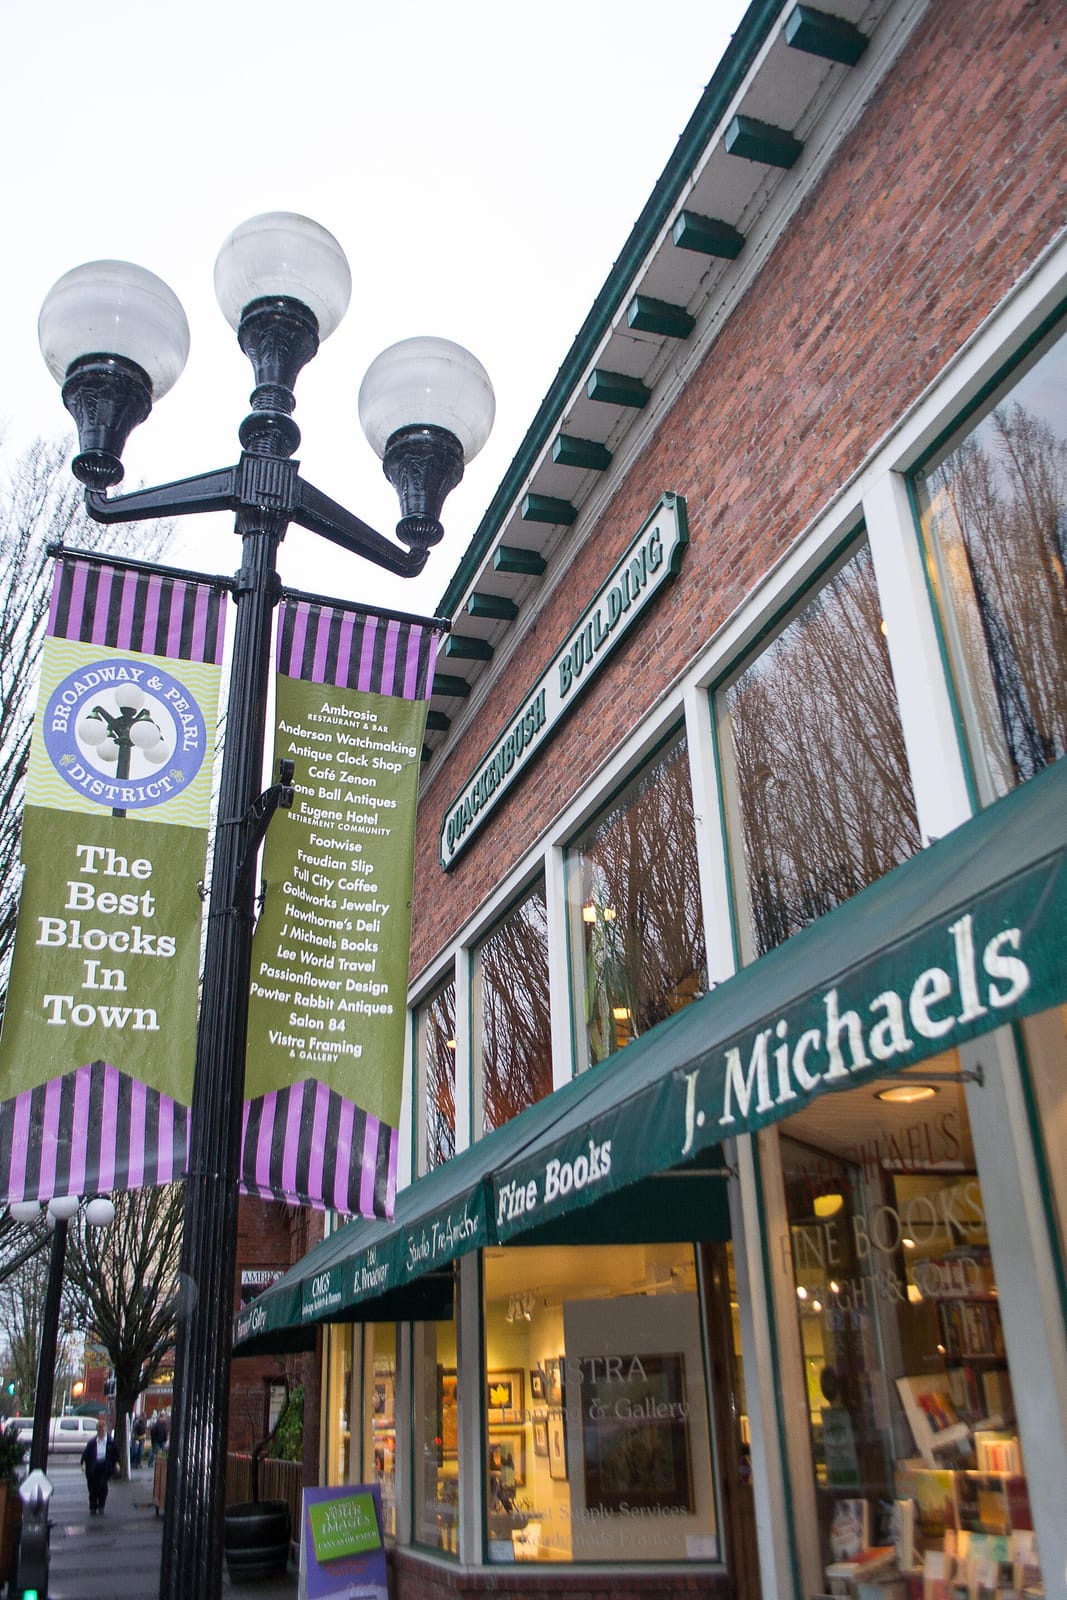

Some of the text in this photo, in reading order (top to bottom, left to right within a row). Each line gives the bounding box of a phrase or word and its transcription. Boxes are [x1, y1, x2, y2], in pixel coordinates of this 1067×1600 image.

[446, 527, 664, 854] QUACKENBUSH BUILDING
[53, 667, 198, 751] BROADWAY & PEARL
[307, 714, 360, 729] RESTAURANT
[372, 724, 389, 733] BAR
[320, 702, 378, 722] Ambrosia
[278, 720, 417, 758] Anderson Watchmaking
[288, 742, 402, 773] Antique Clock Shop
[67, 763, 173, 802] DISTRICT
[308, 766, 377, 787] Café Zenon
[291, 780, 397, 809] one Ball Antiques
[287, 812, 392, 836] RETIREMENT COMMUNITY
[300, 802, 379, 825] Eugene Hotel
[310, 833, 362, 852] Footwise
[76, 844, 153, 879] The
[297, 849, 374, 874] Freudian Slip
[293, 867, 378, 893] Full City Coffee
[64, 881, 156, 917] Best
[282, 881, 390, 916] Goldworks Jewelry
[285, 903, 380, 932] Hawthorne's Deli
[35, 916, 176, 957] Blocks
[280, 924, 379, 952] J Michaels Books
[277, 944, 375, 973] Lee World Travel
[82, 959, 128, 991] In
[260, 962, 388, 996] Passionflower Design
[43, 995, 160, 1030] Town
[250, 983, 393, 1016] Pewter Rabbit Antiques
[289, 1012, 346, 1032] Salon 84
[680, 913, 1031, 1155] J. Michaels
[269, 1030, 362, 1057] Vistra Framing
[300, 1052, 338, 1062] GALLERY
[496, 1140, 611, 1226] Fine Books
[852, 1182, 985, 1258] BOOKS
[589, 1398, 609, 1420] &
[615, 1397, 690, 1422] Gallery
[618, 1501, 688, 1521] Services
